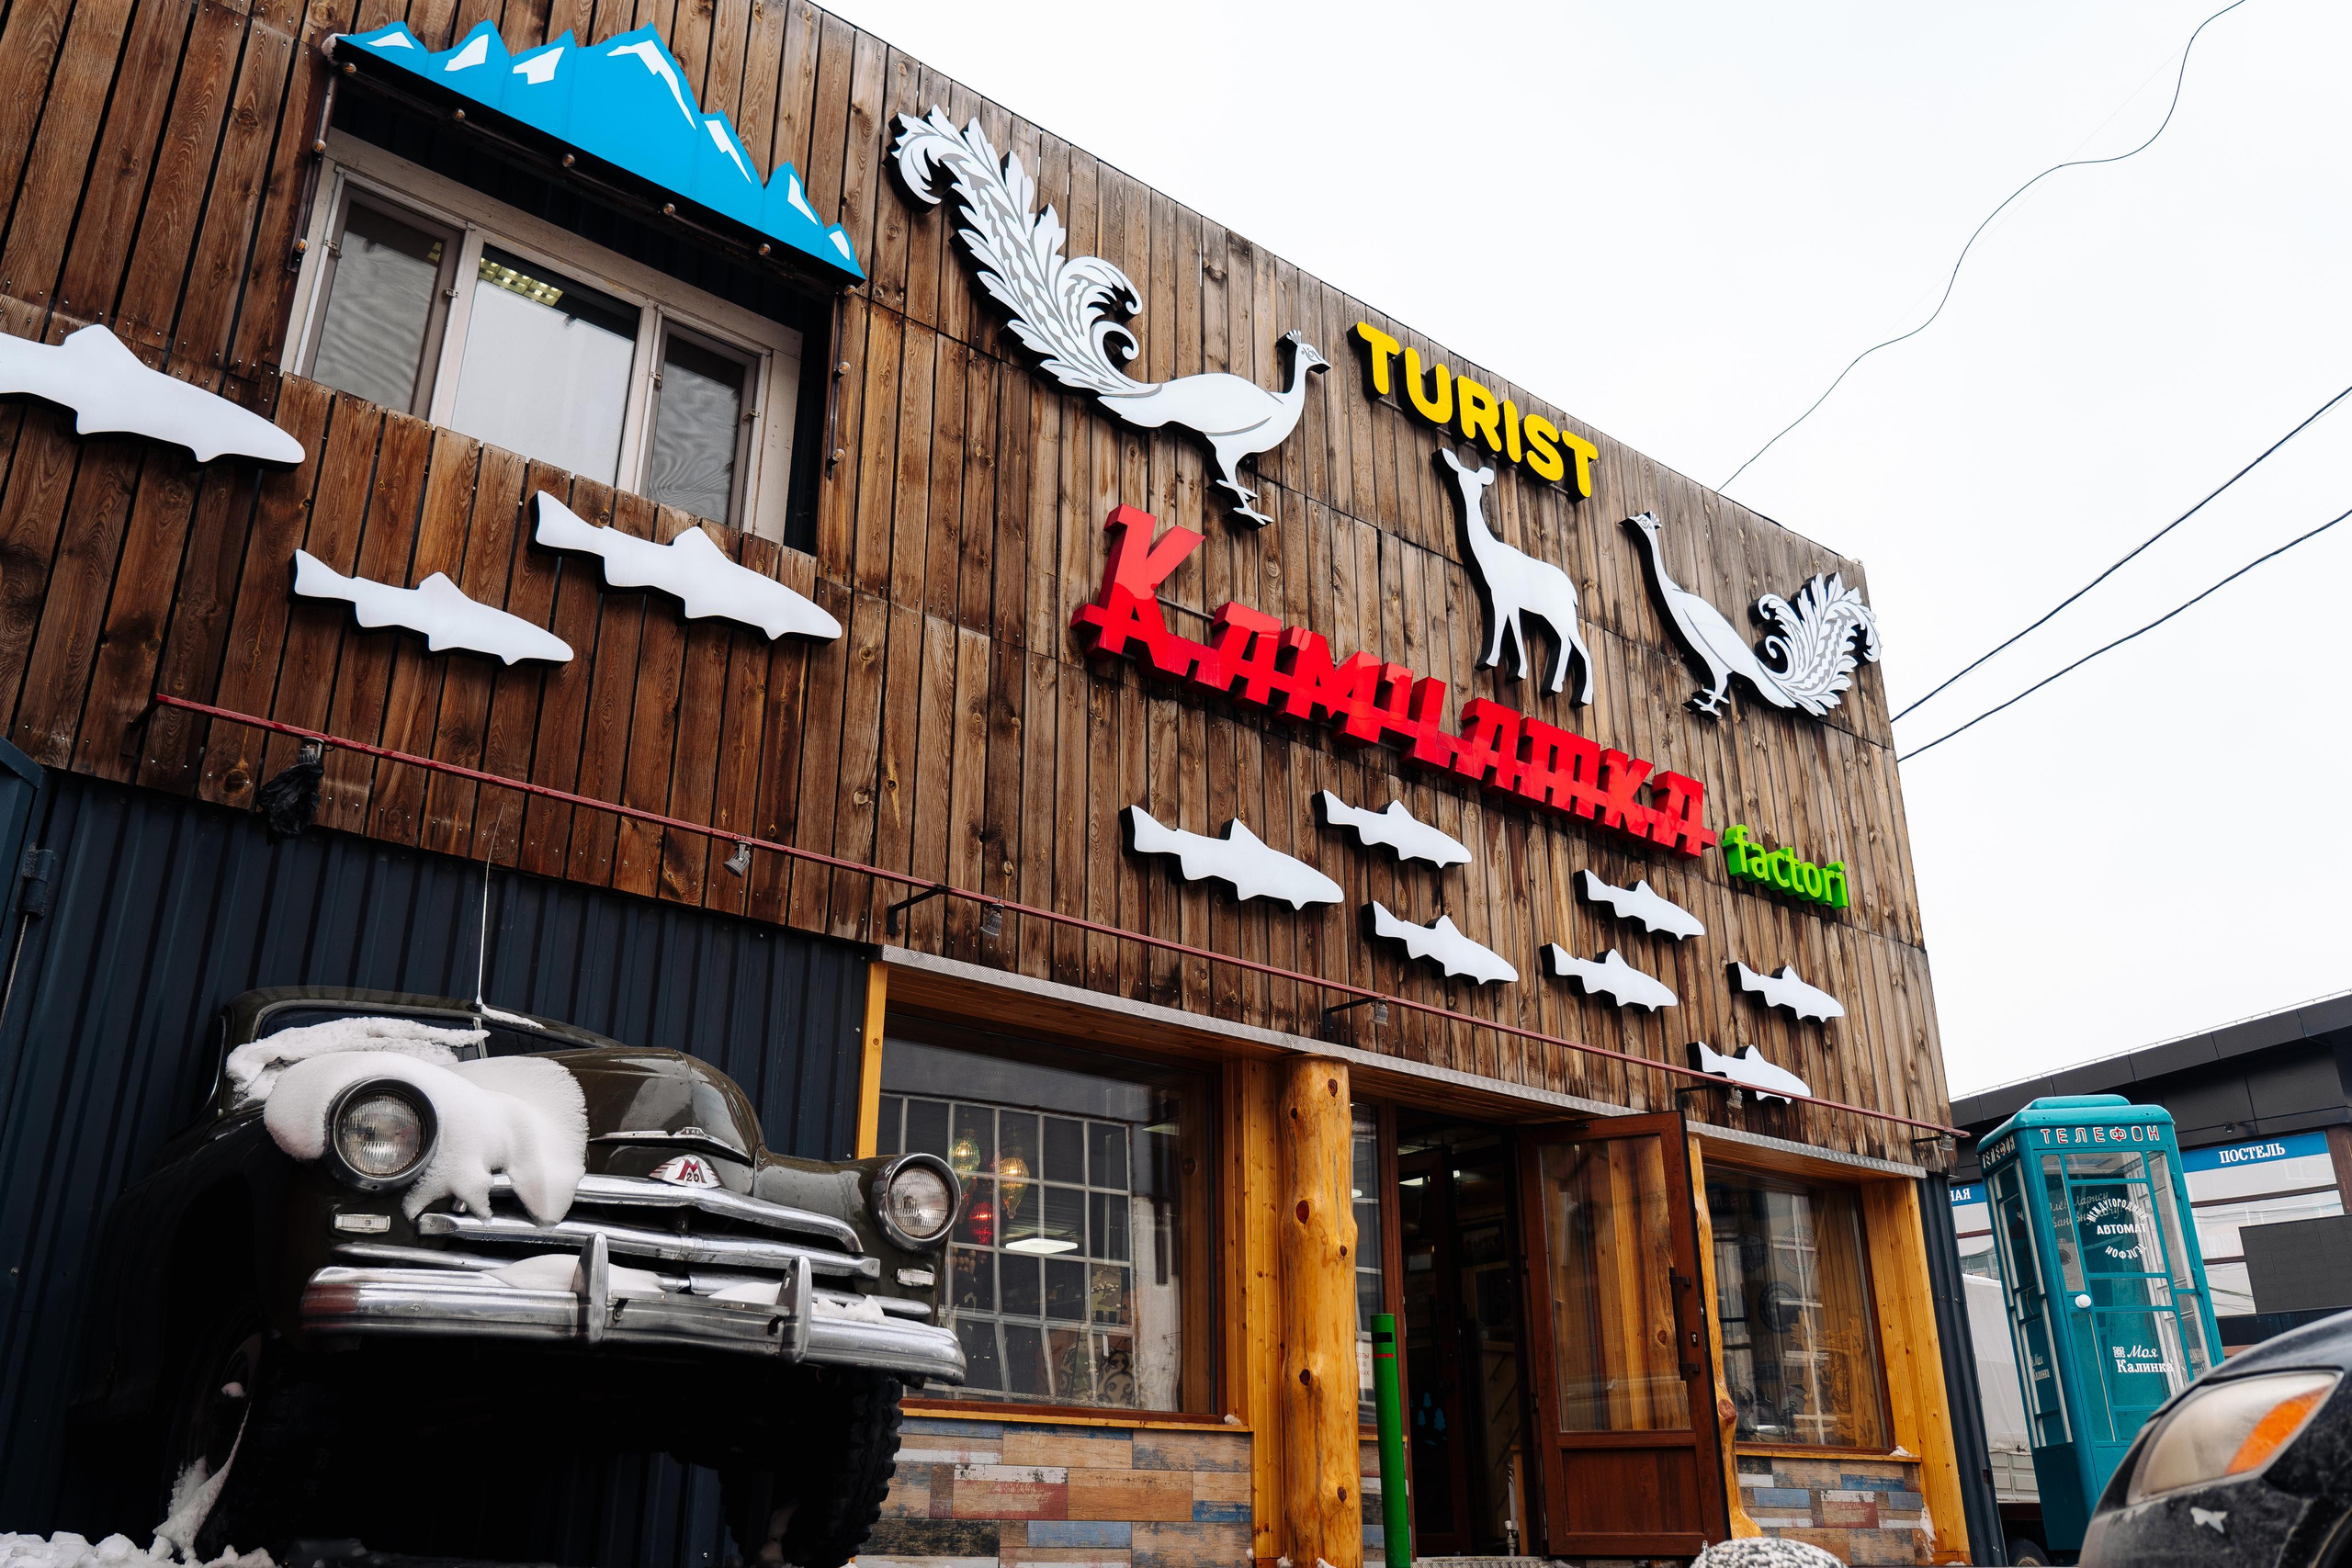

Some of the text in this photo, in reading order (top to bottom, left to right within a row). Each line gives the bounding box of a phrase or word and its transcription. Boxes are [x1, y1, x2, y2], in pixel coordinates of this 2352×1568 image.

[1354, 321, 1599, 498] TURIST
[1724, 824, 1849, 909] factori
[2041, 1125, 2160, 1145] ТЕЛЕФОН
[2218, 1143, 2286, 1164] ПОСТЕЛЬ
[2097, 1224, 2147, 1235] АВТОМАТ
[2127, 1345, 2159, 1359] Моя
[2116, 1359, 2175, 1373] Калинка
